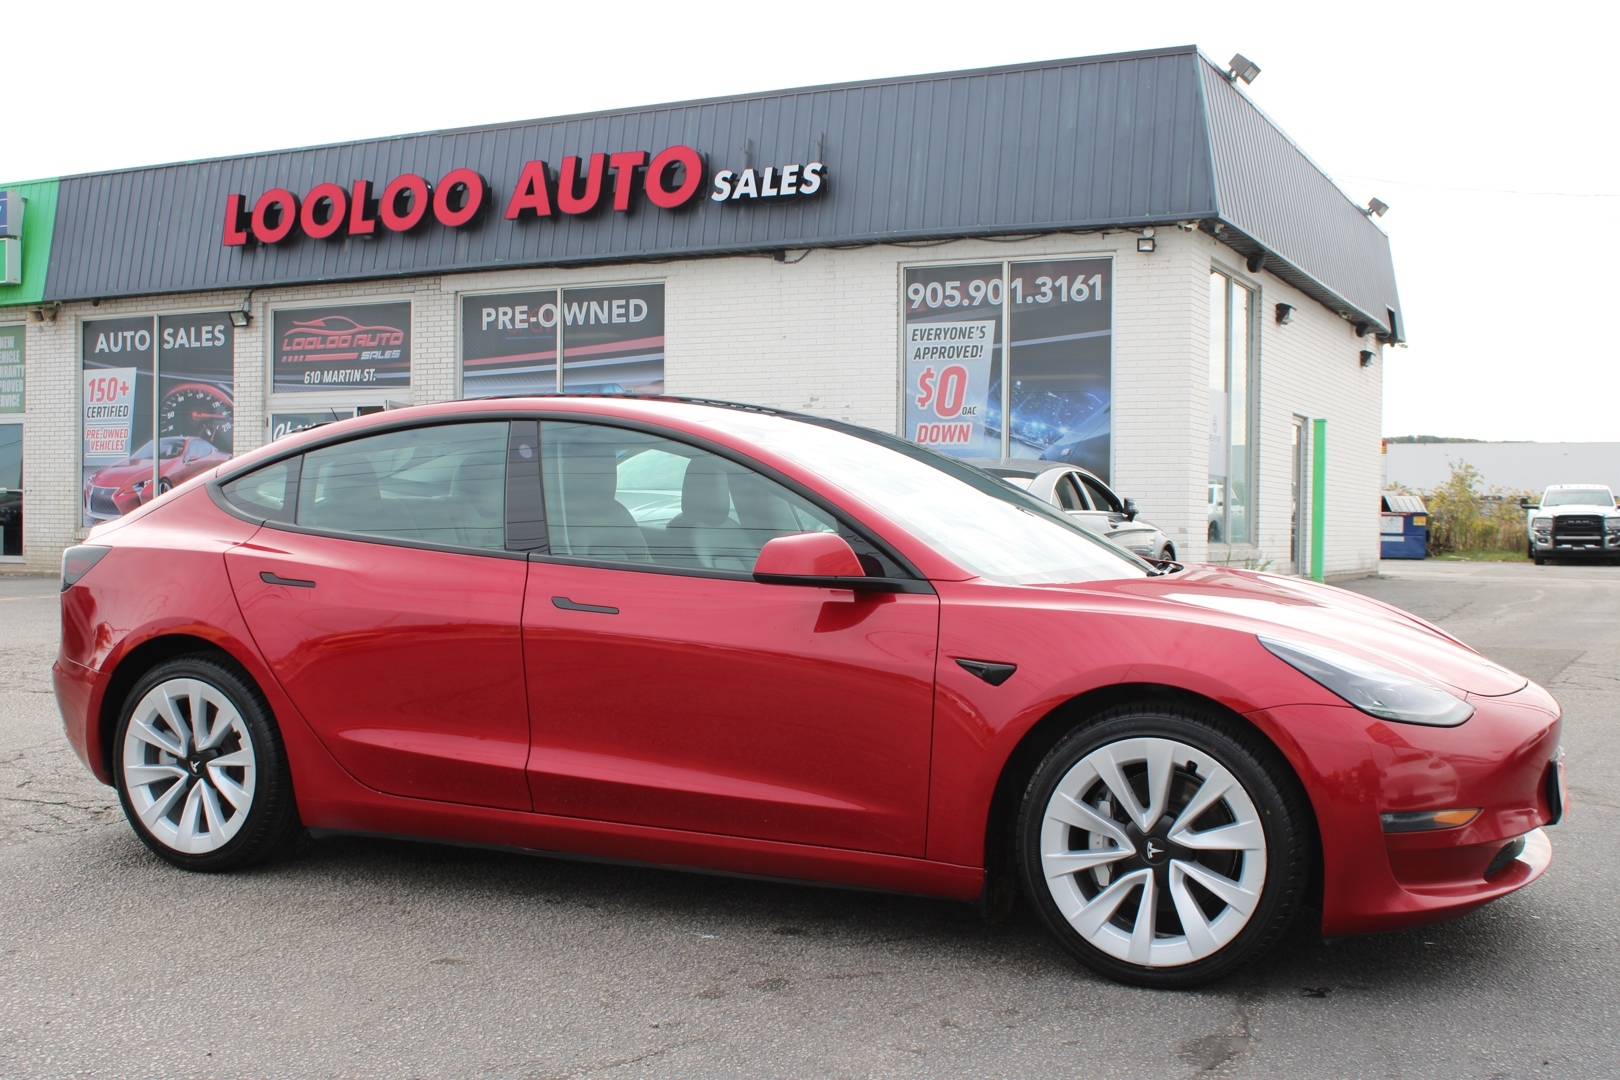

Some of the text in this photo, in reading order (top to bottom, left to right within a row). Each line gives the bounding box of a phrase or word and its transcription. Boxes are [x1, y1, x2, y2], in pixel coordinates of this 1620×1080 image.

[222, 144, 824, 247] LOOLOO AUTO SALES
[906, 273, 1103, 309] 905.901.3161
[481, 298, 648, 331] PRE-OWNED
[94, 324, 226, 353] AUTO SALES
[282, 332, 405, 351] LOOLOO AUTO
[911, 325, 987, 342] EVERYONE'S
[360, 349, 402, 360] SALES
[913, 345, 984, 360] APPROVED!
[303, 368, 376, 384] 610 MARTIN ST.
[88, 377, 130, 403] 150+
[916, 365, 968, 418] $0
[86, 405, 129, 419] CERTIFIED
[961, 406, 977, 416] OAC
[86, 428, 129, 440] PRE-OWNED
[916, 424, 971, 444] DOWN
[90, 440, 125, 451] VEHICLES
